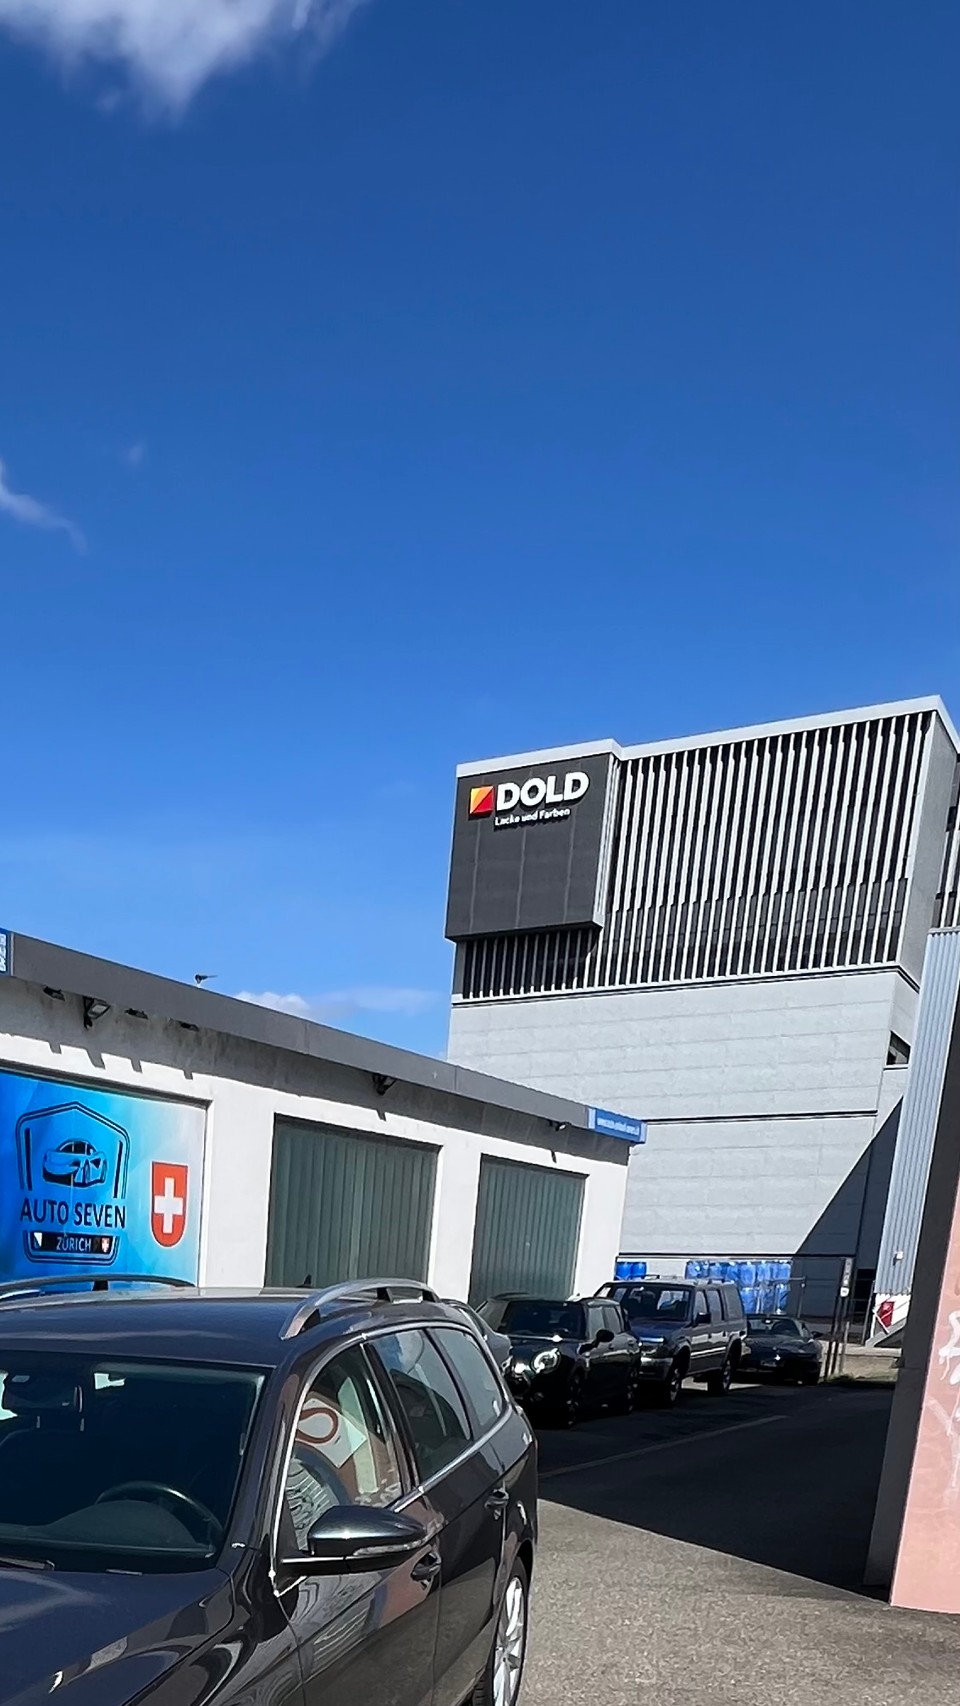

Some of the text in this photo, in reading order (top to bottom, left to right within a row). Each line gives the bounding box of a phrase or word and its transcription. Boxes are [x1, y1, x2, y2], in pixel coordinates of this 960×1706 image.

[496, 771, 590, 811] DOLD
[521, 810, 539, 822] und
[539, 808, 571, 820] Farben
[20, 1197, 126, 1229] AUTO SEVEN
[56, 1236, 92, 1252] ZÜRICH
